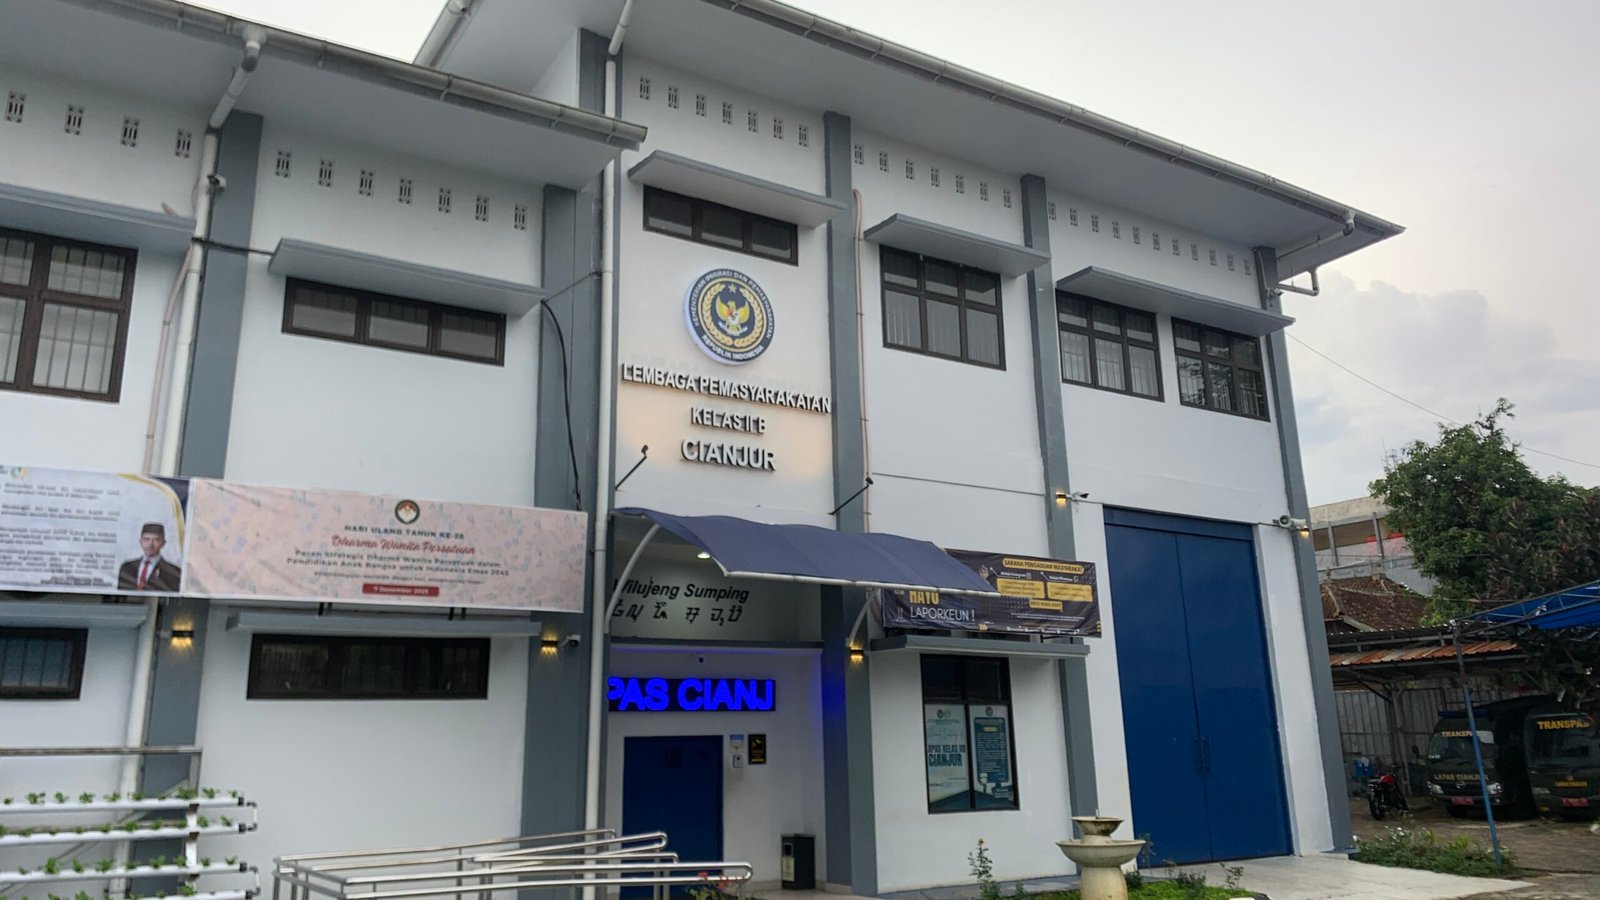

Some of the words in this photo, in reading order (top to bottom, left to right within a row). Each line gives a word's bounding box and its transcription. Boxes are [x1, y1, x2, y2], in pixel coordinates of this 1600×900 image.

[733, 271, 748, 282] DAN
[701, 334, 732, 359] REPUBLIK
[732, 345, 764, 360] INDONESIA
[621, 363, 698, 392] LEMBAGA
[699, 378, 832, 415] PEMASYARAKATAN
[691, 407, 743, 431] KELAS
[682, 439, 776, 471] CIANJUR
[344, 525, 368, 533] HARI
[371, 527, 402, 535] ULANG
[405, 529, 437, 538] TAHUN
[331, 534, 378, 548] Dharma
[380, 539, 421, 551] Wanita
[422, 541, 476, 555] Persatuan
[287, 558, 338, 566] Pendidikan
[341, 560, 362, 568] Anak
[365, 562, 397, 571] Bangsa
[399, 564, 423, 572] untuk
[426, 565, 466, 574] Indonesia
[468, 568, 489, 576] Emas
[367, 553, 400, 561] Dharma
[403, 556, 432, 564] Wanita
[434, 558, 475, 566] Persatuan
[684, 583, 750, 604] Sumping
[910, 606, 970, 621] LAPORKEUN
[677, 678, 773, 711] CIANJ
